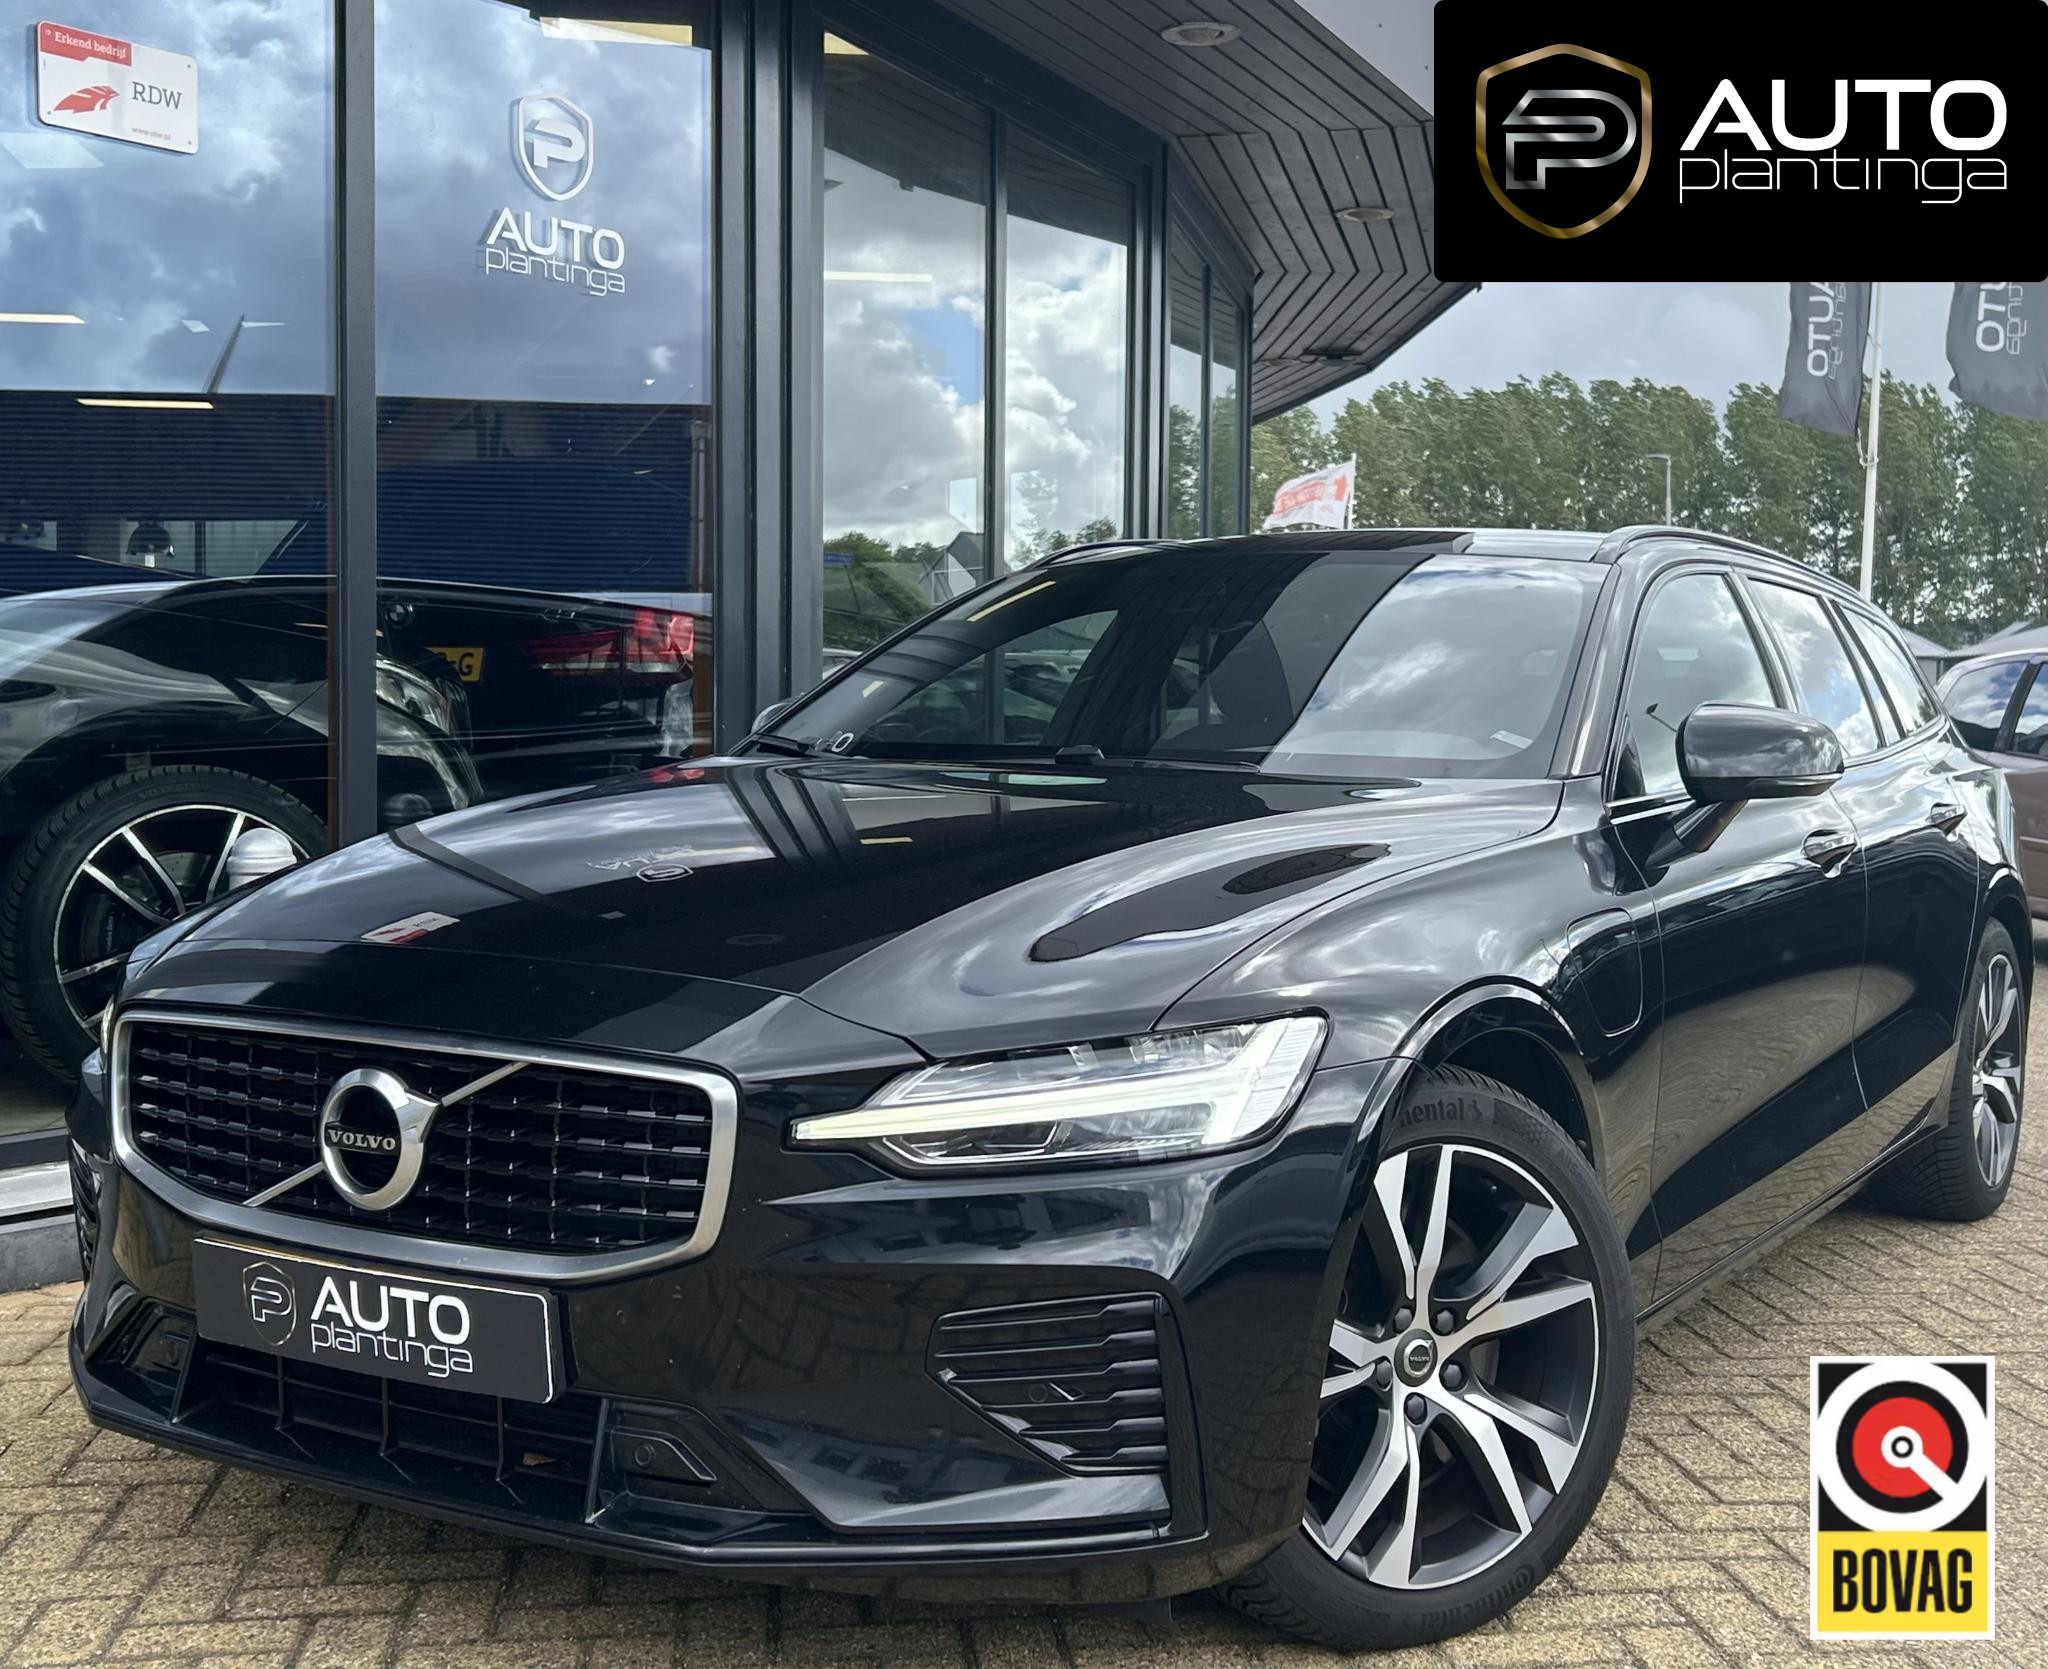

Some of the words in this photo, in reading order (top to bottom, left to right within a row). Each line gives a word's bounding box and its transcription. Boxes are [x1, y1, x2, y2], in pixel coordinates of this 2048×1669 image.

[54, 31, 92, 50] Erkend
[94, 40, 127, 59] bedrijf
[131, 81, 183, 110] RDW
[486, 207, 625, 269] AUTO
[485, 247, 625, 296] plantinga
[327, 1129, 396, 1151] VOLVO
[310, 1276, 470, 1345] AUTO
[311, 1321, 473, 1378] plantinga
